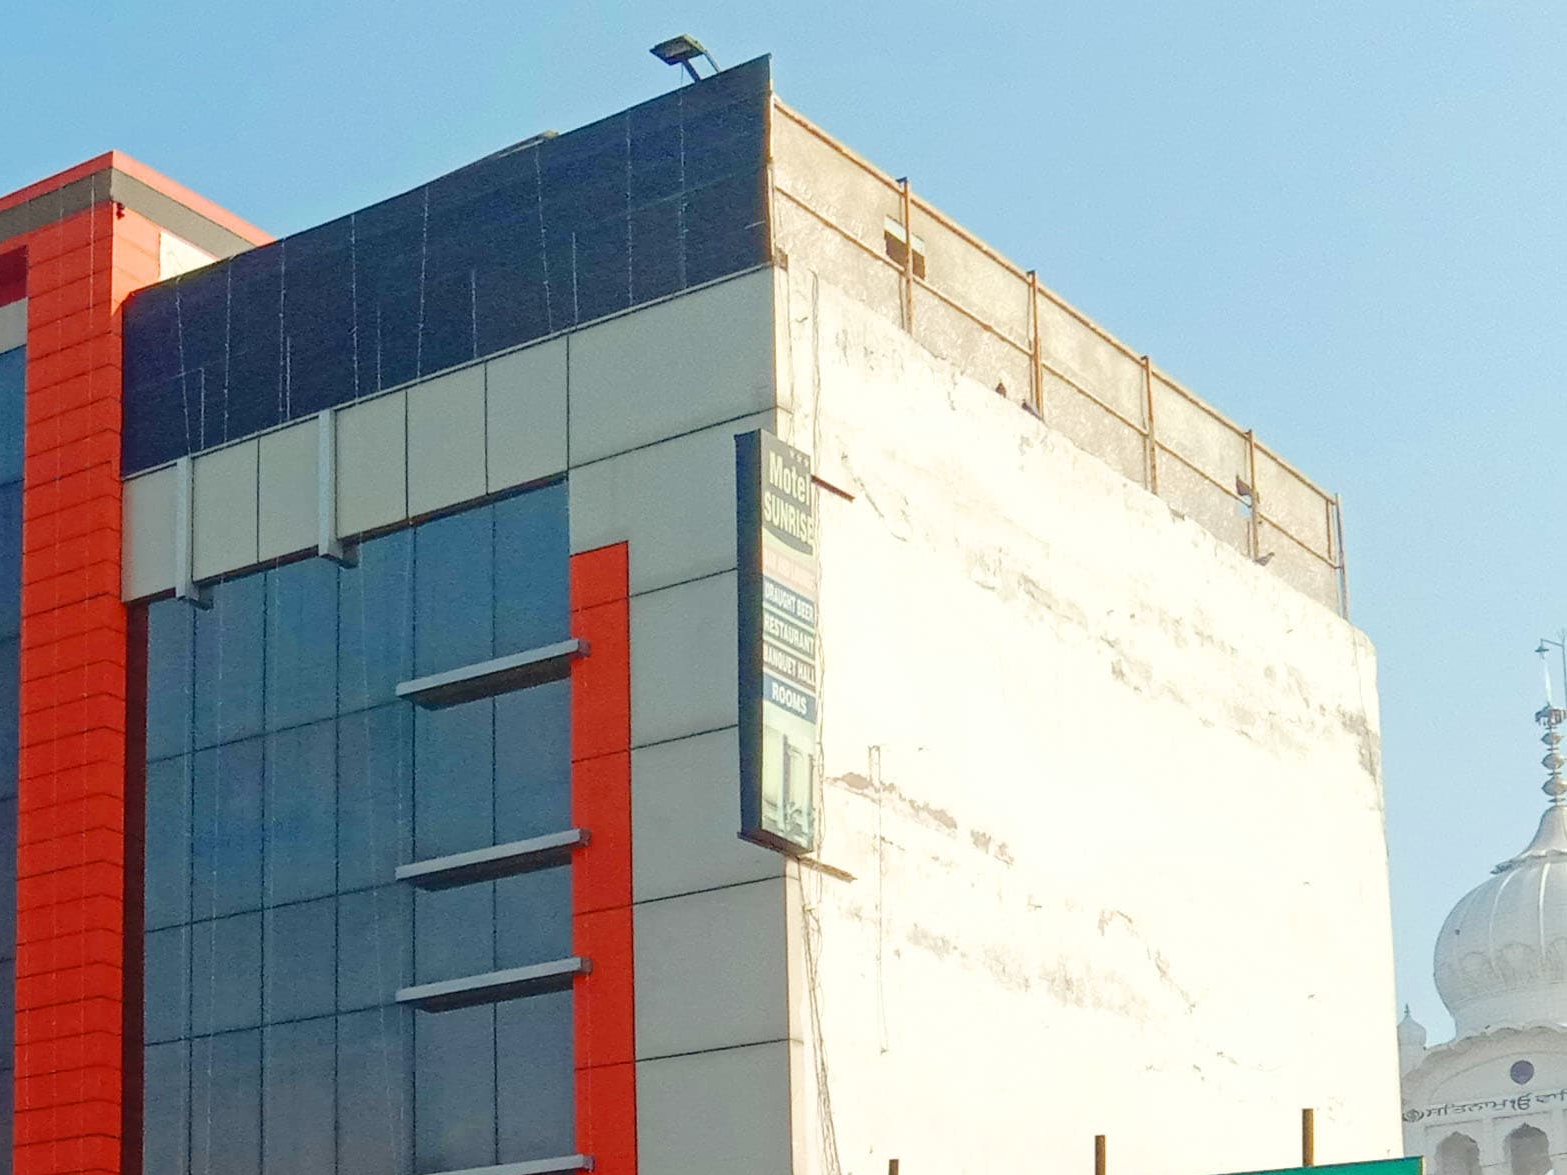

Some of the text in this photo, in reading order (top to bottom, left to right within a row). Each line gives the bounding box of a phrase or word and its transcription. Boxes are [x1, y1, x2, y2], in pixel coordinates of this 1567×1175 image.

[769, 449, 810, 505] Motel
[764, 491, 814, 546] SUNRISE
[764, 614, 814, 655] RESTAURANT
[771, 681, 808, 715] ROOMS
